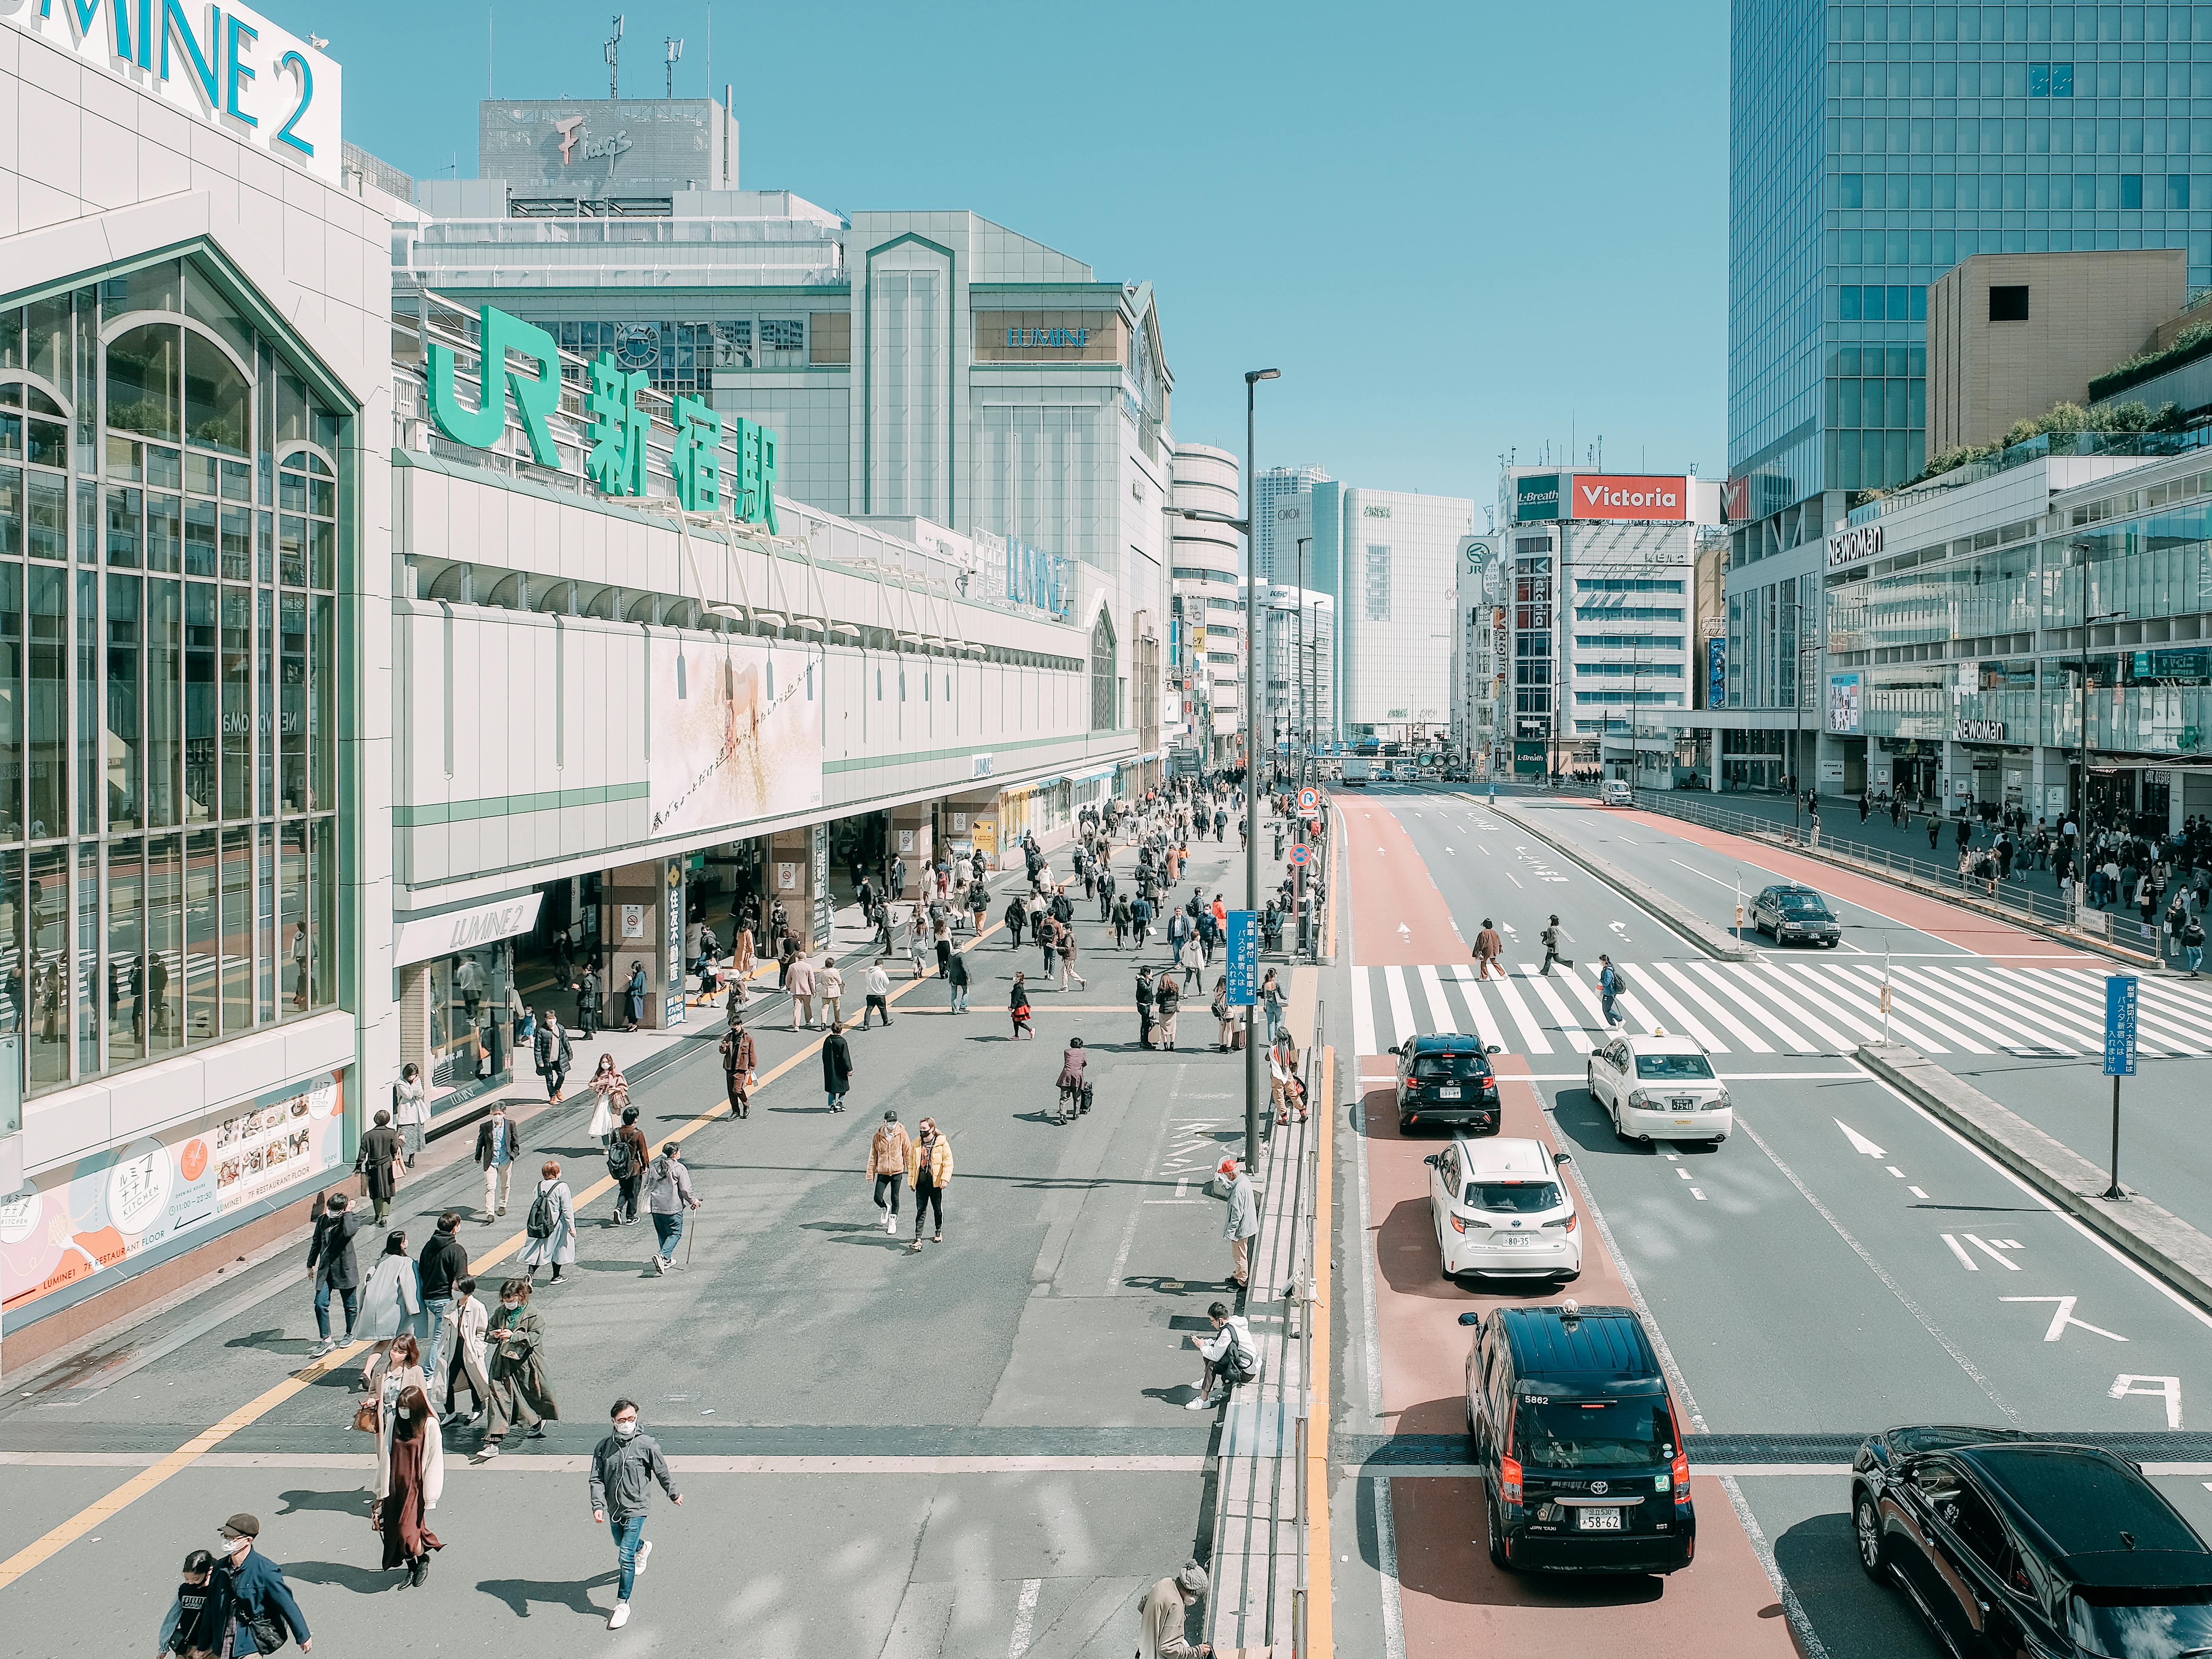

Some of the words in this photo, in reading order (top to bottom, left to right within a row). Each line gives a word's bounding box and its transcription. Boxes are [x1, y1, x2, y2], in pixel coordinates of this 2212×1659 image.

[274, 50, 314, 157] 2
[555, 116, 633, 177] Flags
[1008, 328, 1090, 347] LUMINE
[1518, 490, 1558, 502] L-Breath
[1581, 485, 1676, 507] Victoria
[1467, 565, 1482, 574] JR
[1517, 753, 1543, 761] L-Breath
[450, 910, 510, 949] LUMINE
[509, 904, 524, 933] 2
[670, 890, 679, 982] 住友不動産
[1246, 915, 1255, 996] 一般車・原付・自転車は
[2117, 996, 2125, 1055] バスタ新宿へは
[2108, 1030, 2116, 1072] 入れません
[449, 1087, 476, 1105] LUMINE
[123, 1184, 159, 1216] KITCHEN
[175, 1188, 192, 1199] OPENING
[217, 1197, 242, 1213] LUMINE1
[256, 1174, 291, 1195] RESTAURANT
[292, 1166, 310, 1181] FLOOR
[43, 1269, 76, 1289] LUMINE1
[83, 1262, 92, 1271] 7F
[95, 1241, 140, 1267] RESTAURANT
[142, 1230, 165, 1246] FLOOR
[1525, 1395, 1549, 1405] 5862
[1588, 1516, 1619, 1528] 58-62
